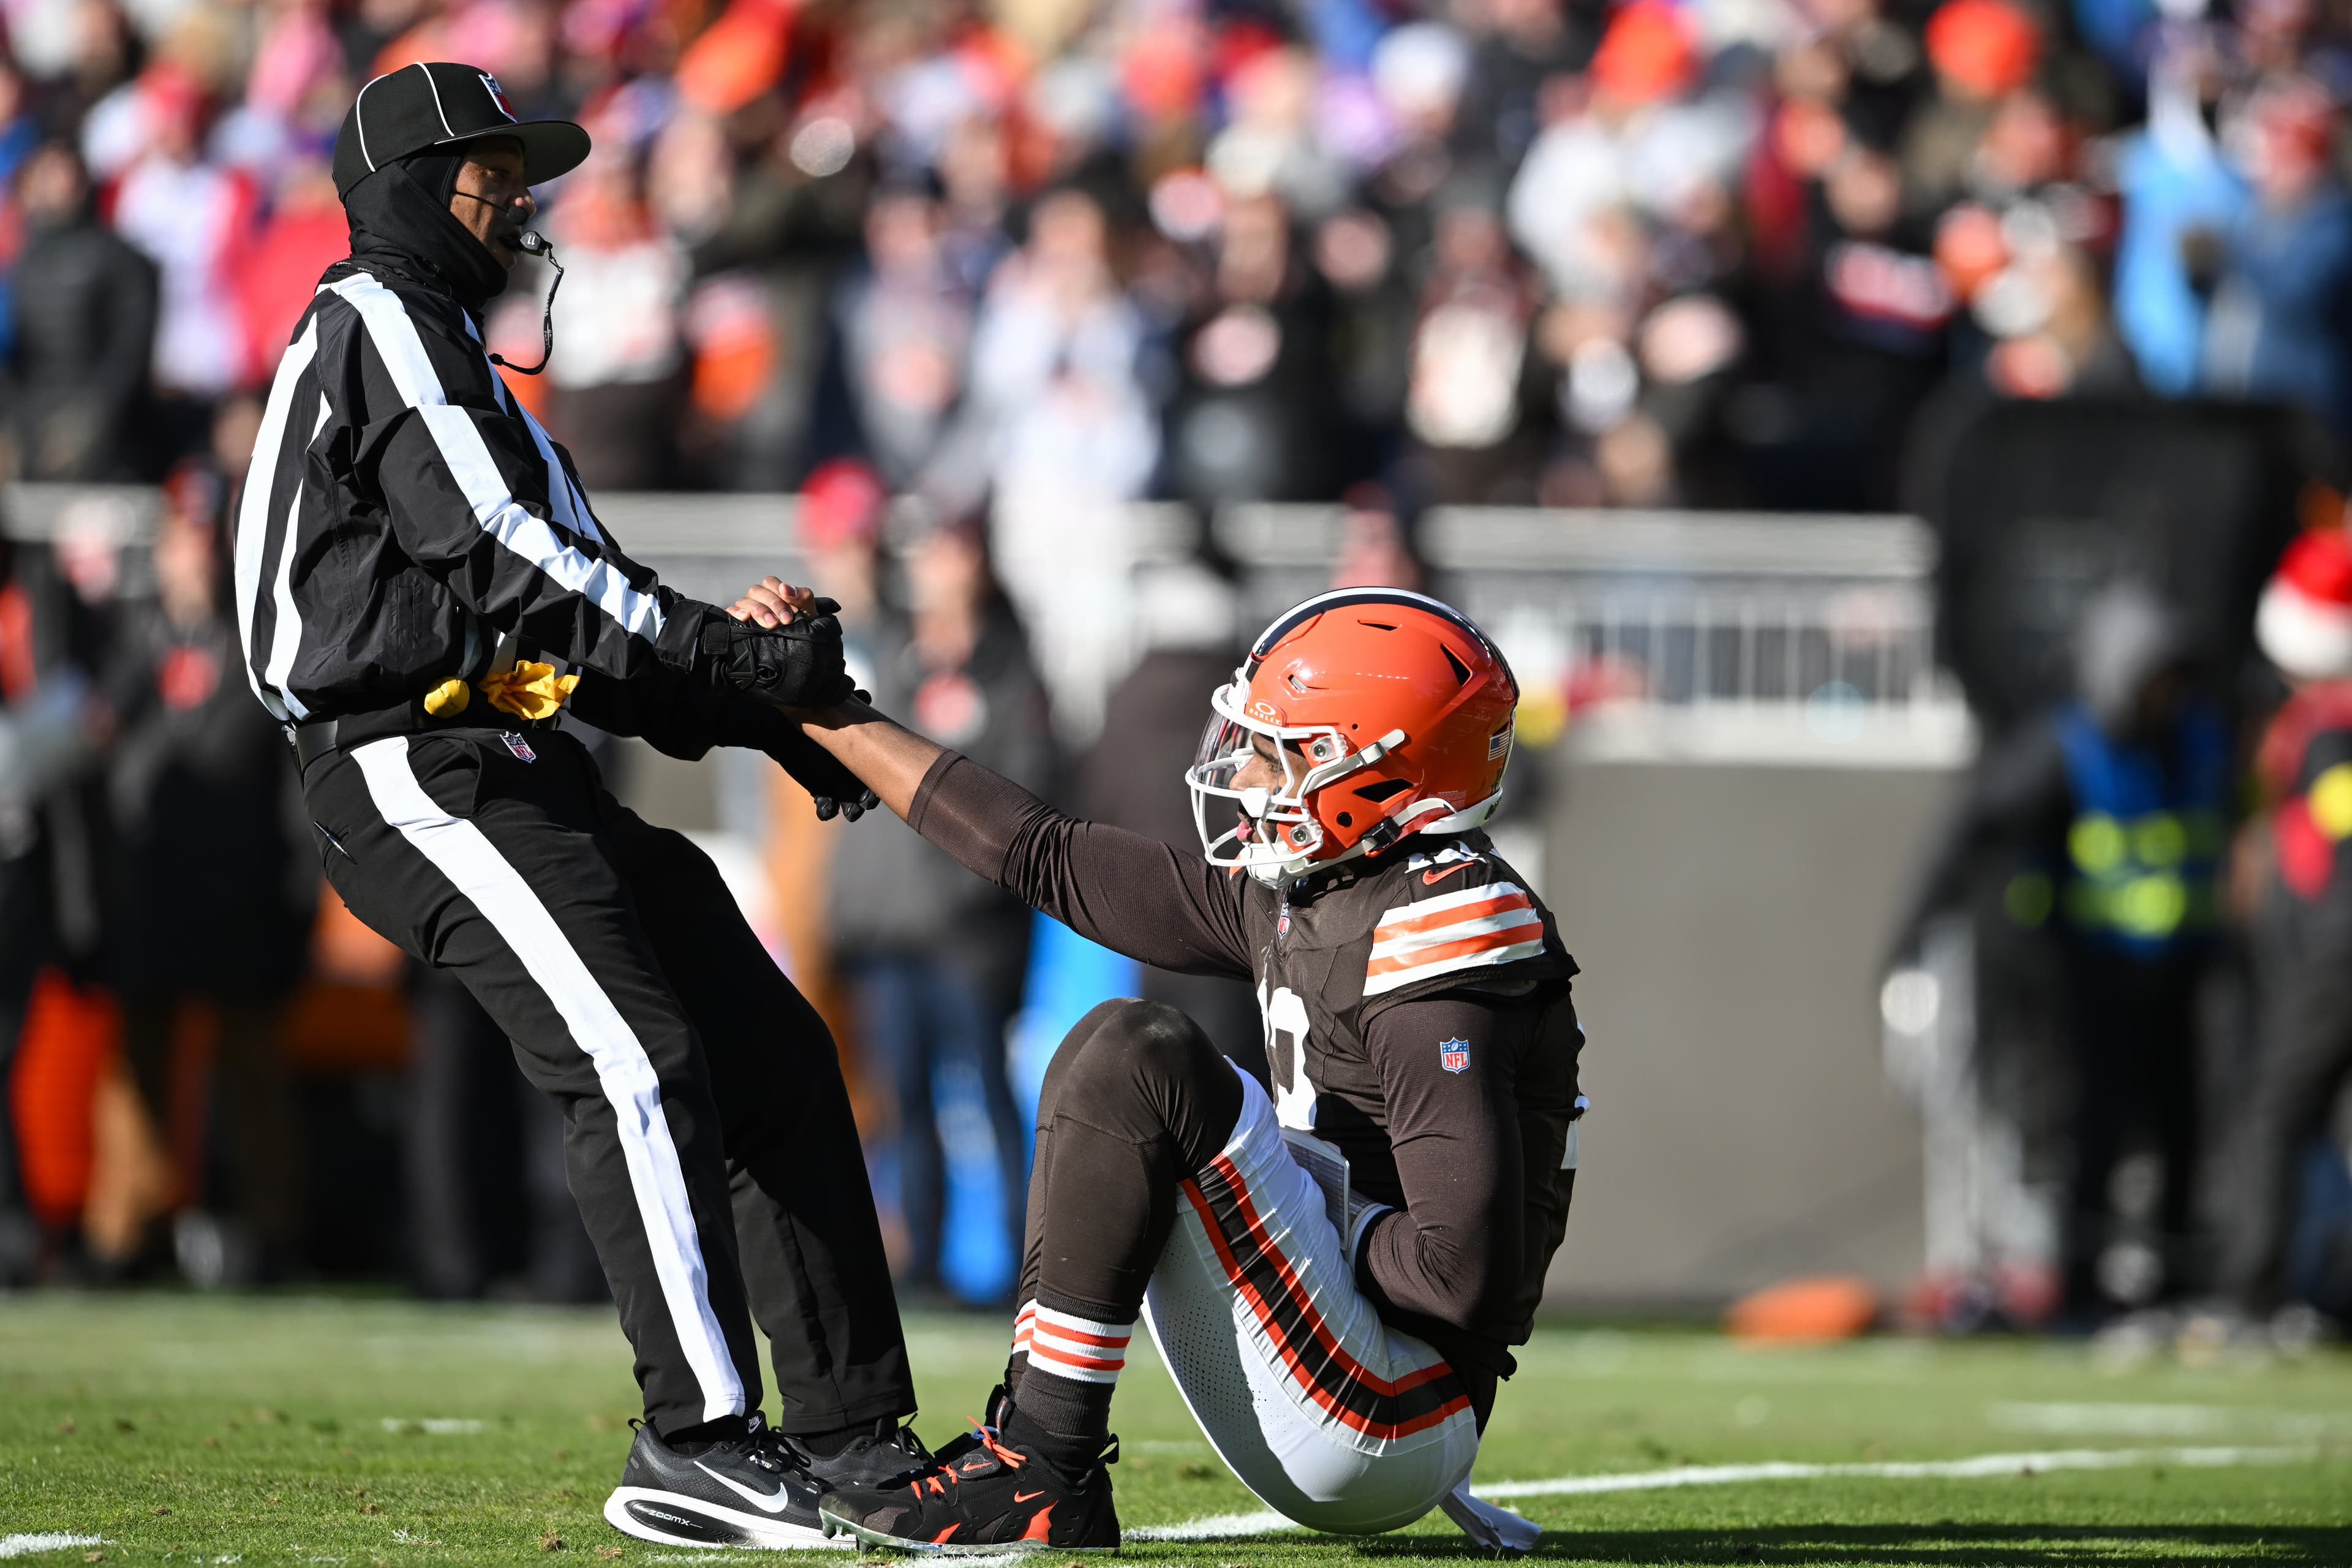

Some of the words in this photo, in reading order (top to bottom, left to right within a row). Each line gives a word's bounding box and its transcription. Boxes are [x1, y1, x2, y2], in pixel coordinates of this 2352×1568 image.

[1250, 708, 1280, 724] OAKLEY
[1446, 1053, 1468, 1068] NFL
[748, 1415, 760, 1427] RUN
